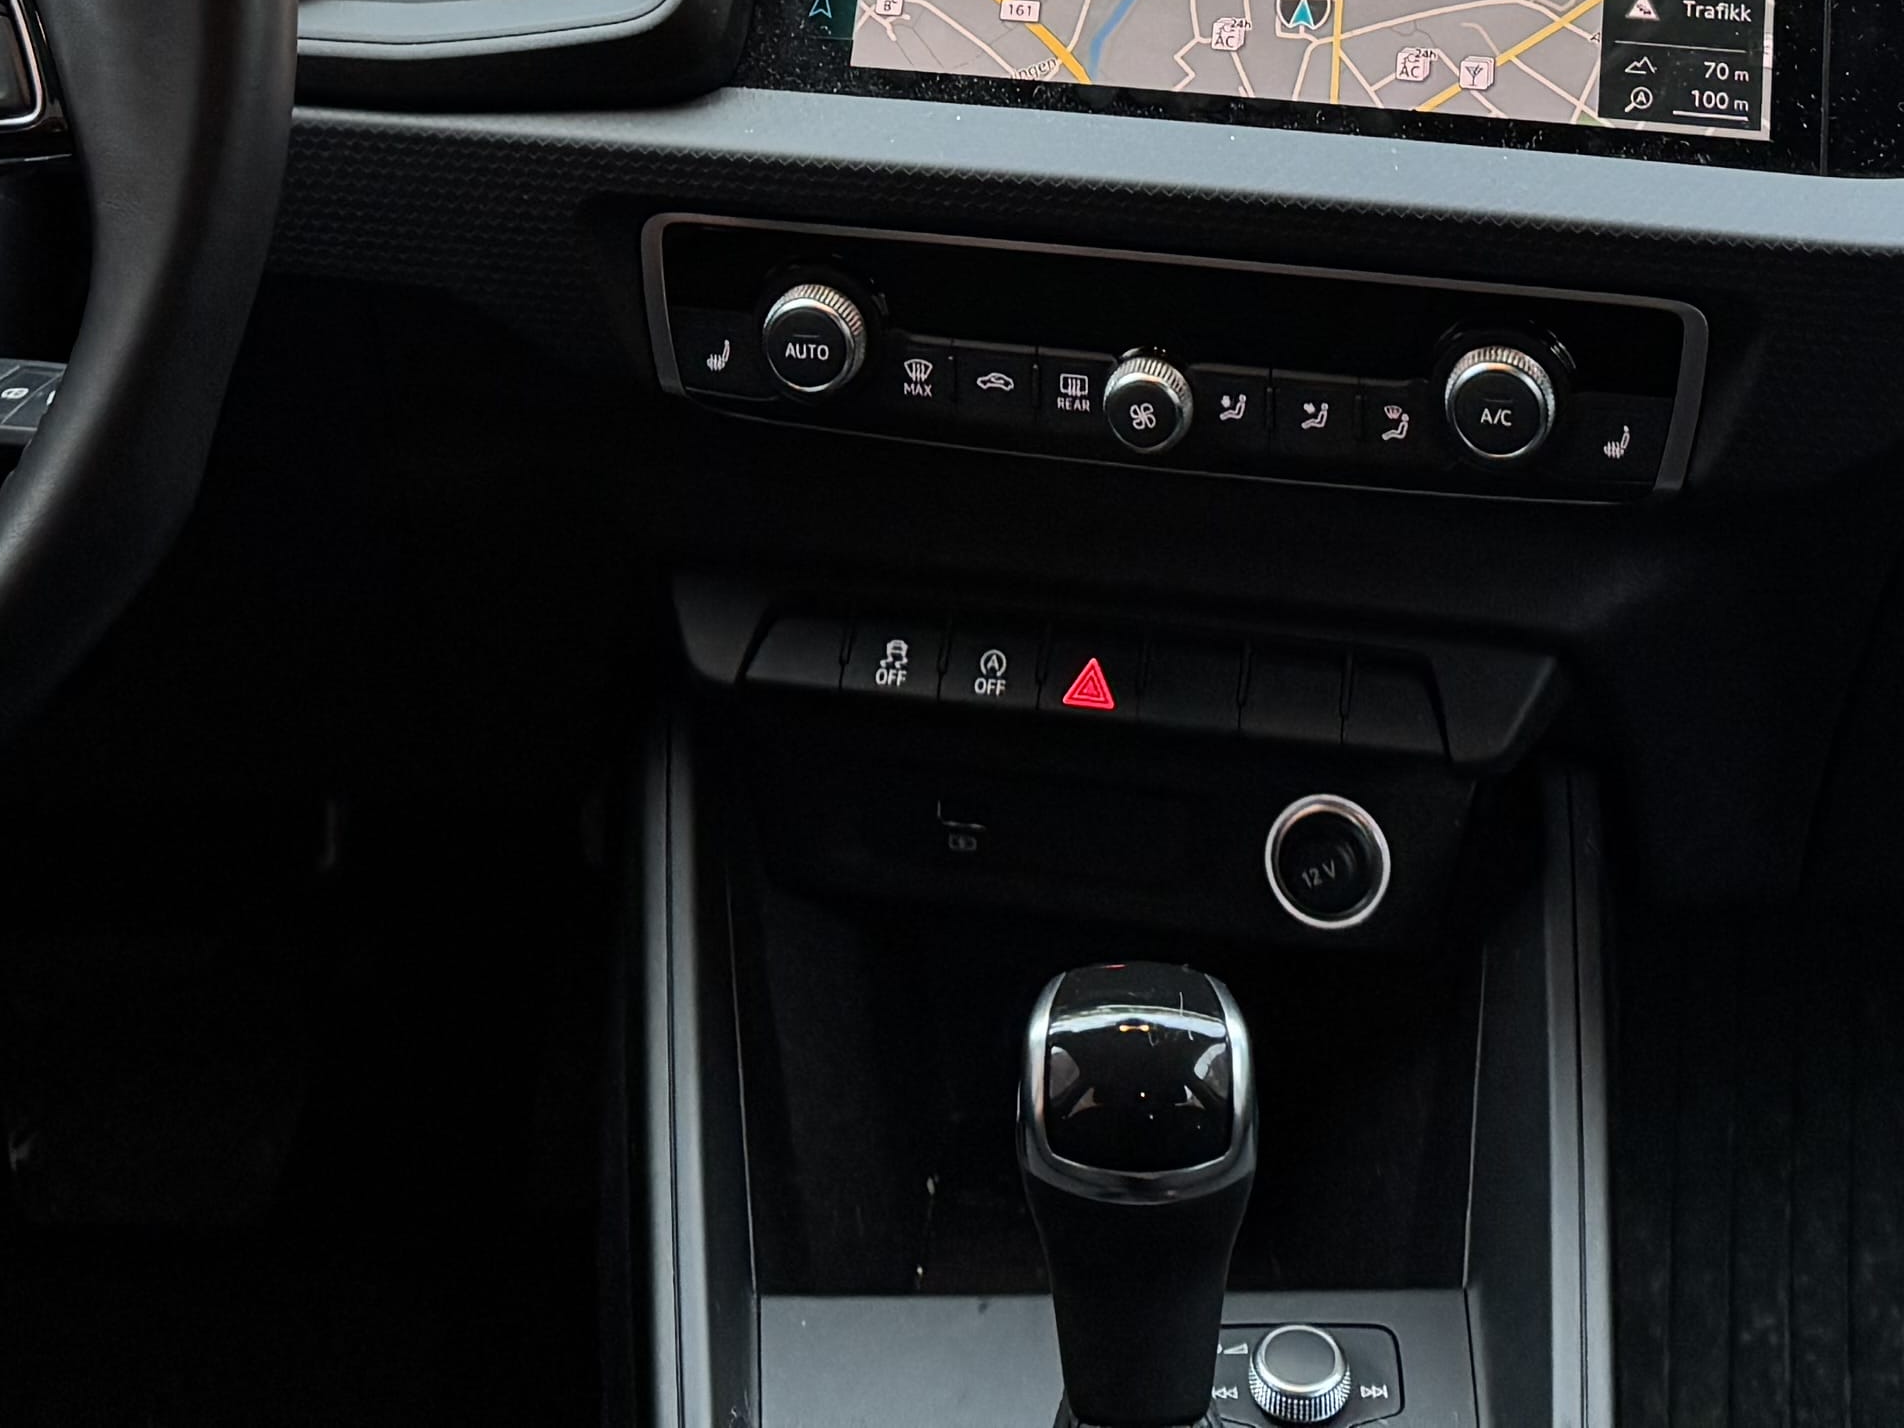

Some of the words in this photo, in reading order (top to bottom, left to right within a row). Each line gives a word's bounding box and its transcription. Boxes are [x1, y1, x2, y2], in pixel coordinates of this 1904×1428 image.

[1007, 3, 1034, 17] 161
[1683, 0, 1752, 23] Trafikk
[1703, 61, 1730, 82] 70
[1734, 69, 1750, 82] m
[1691, 89, 1729, 110] 100
[1733, 97, 1749, 111] m
[785, 343, 829, 361] AUTO
[904, 383, 932, 397] MAX
[1057, 397, 1090, 412] REAR
[1480, 408, 1512, 427] A/C
[875, 668, 907, 687] OFF
[974, 677, 1006, 696] OFF
[1301, 867, 1324, 889] 12
